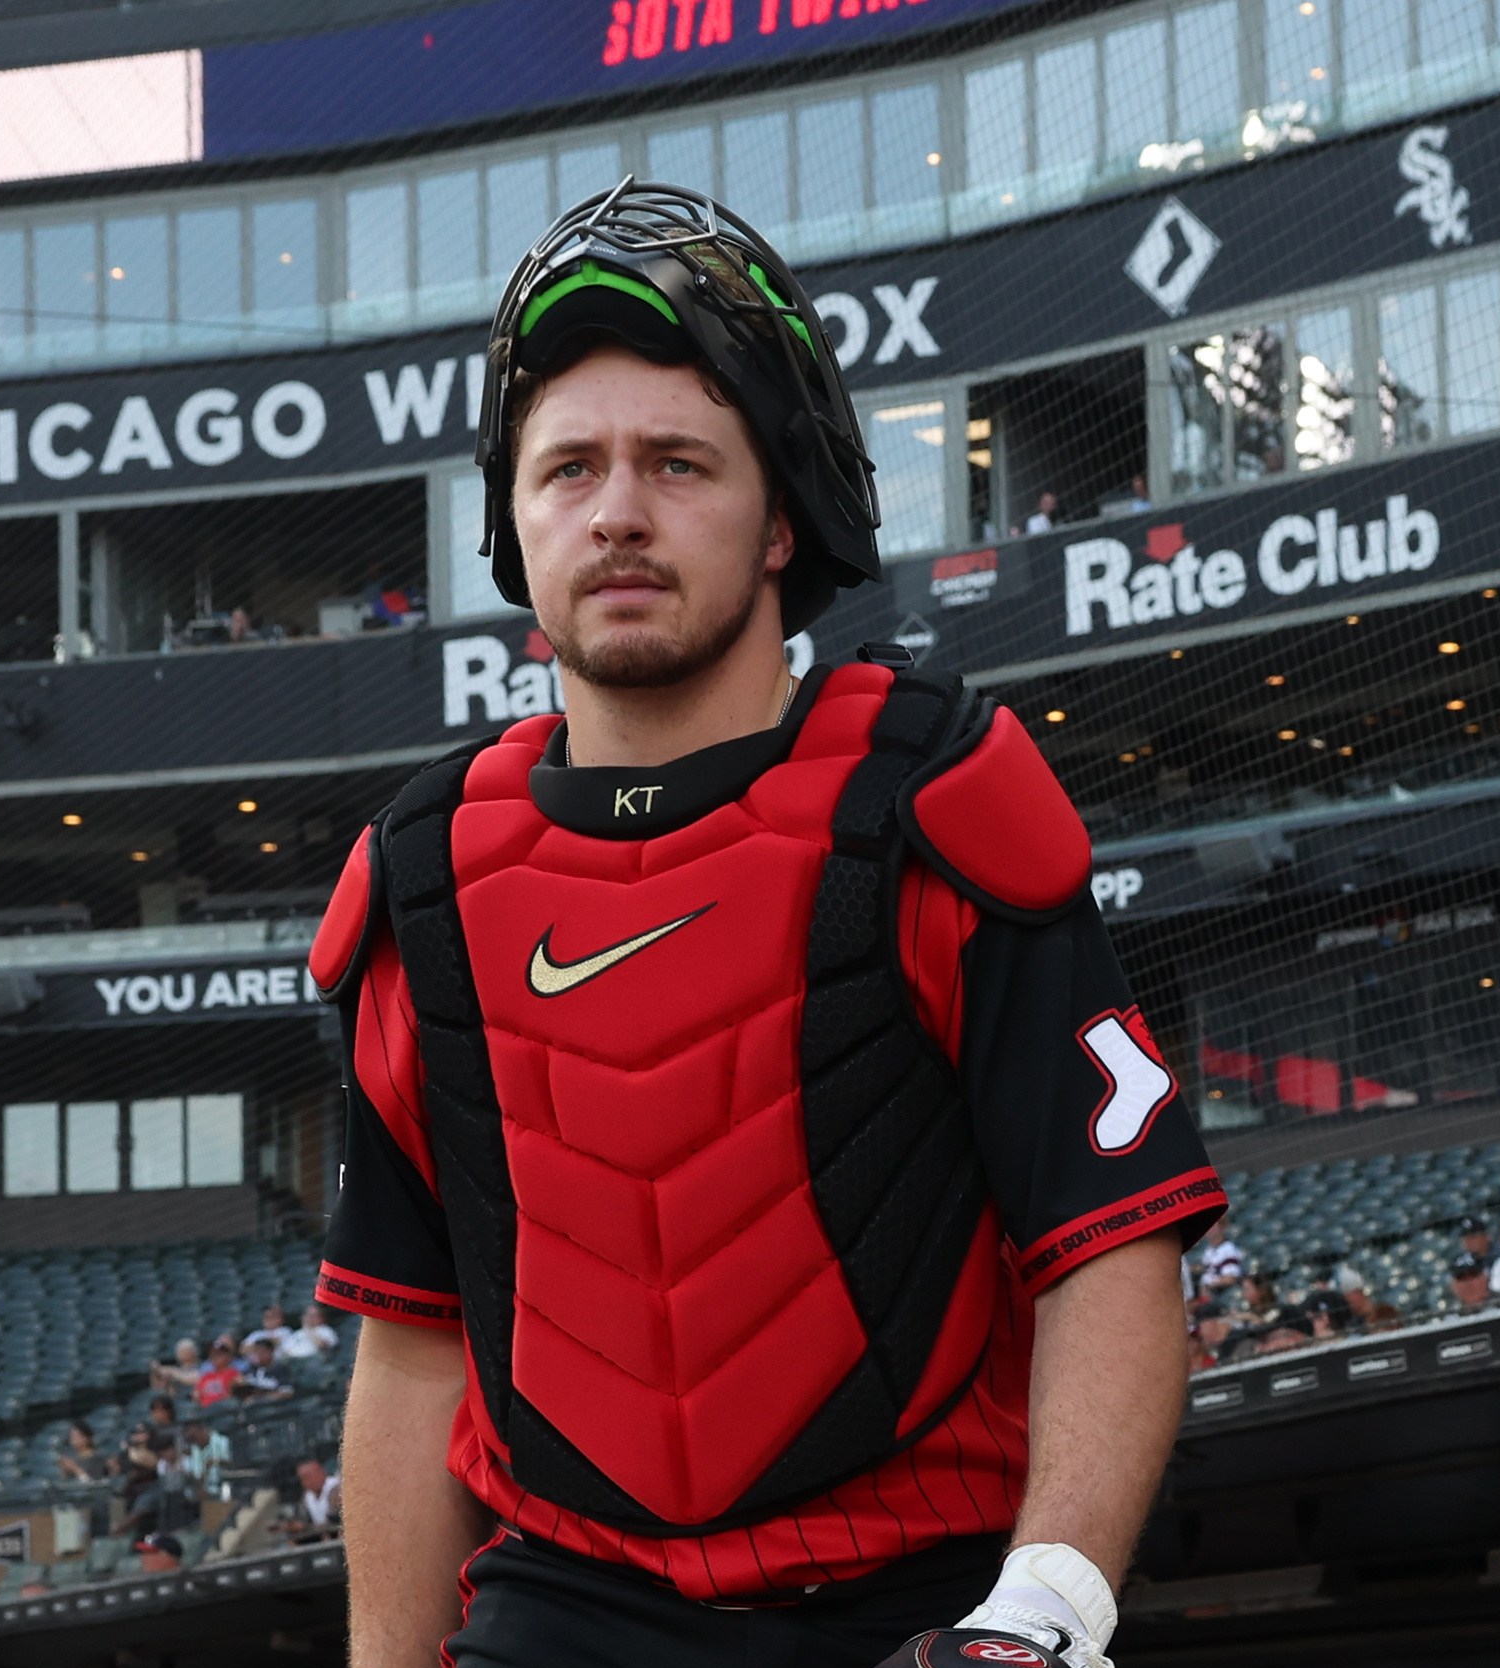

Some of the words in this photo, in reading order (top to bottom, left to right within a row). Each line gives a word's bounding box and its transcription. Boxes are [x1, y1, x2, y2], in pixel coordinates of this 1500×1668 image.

[834, 277, 941, 370] OX
[1064, 537, 1248, 636] Rate
[1258, 495, 1439, 597] Club
[443, 636, 565, 727] Rat
[614, 786, 663, 817] KT
[95, 973, 196, 1016] YOU
[201, 966, 299, 1009] ARE
[1060, 1206, 1146, 1255] SOUTHSIDE
[361, 1288, 444, 1318] SOUTHSIDE
